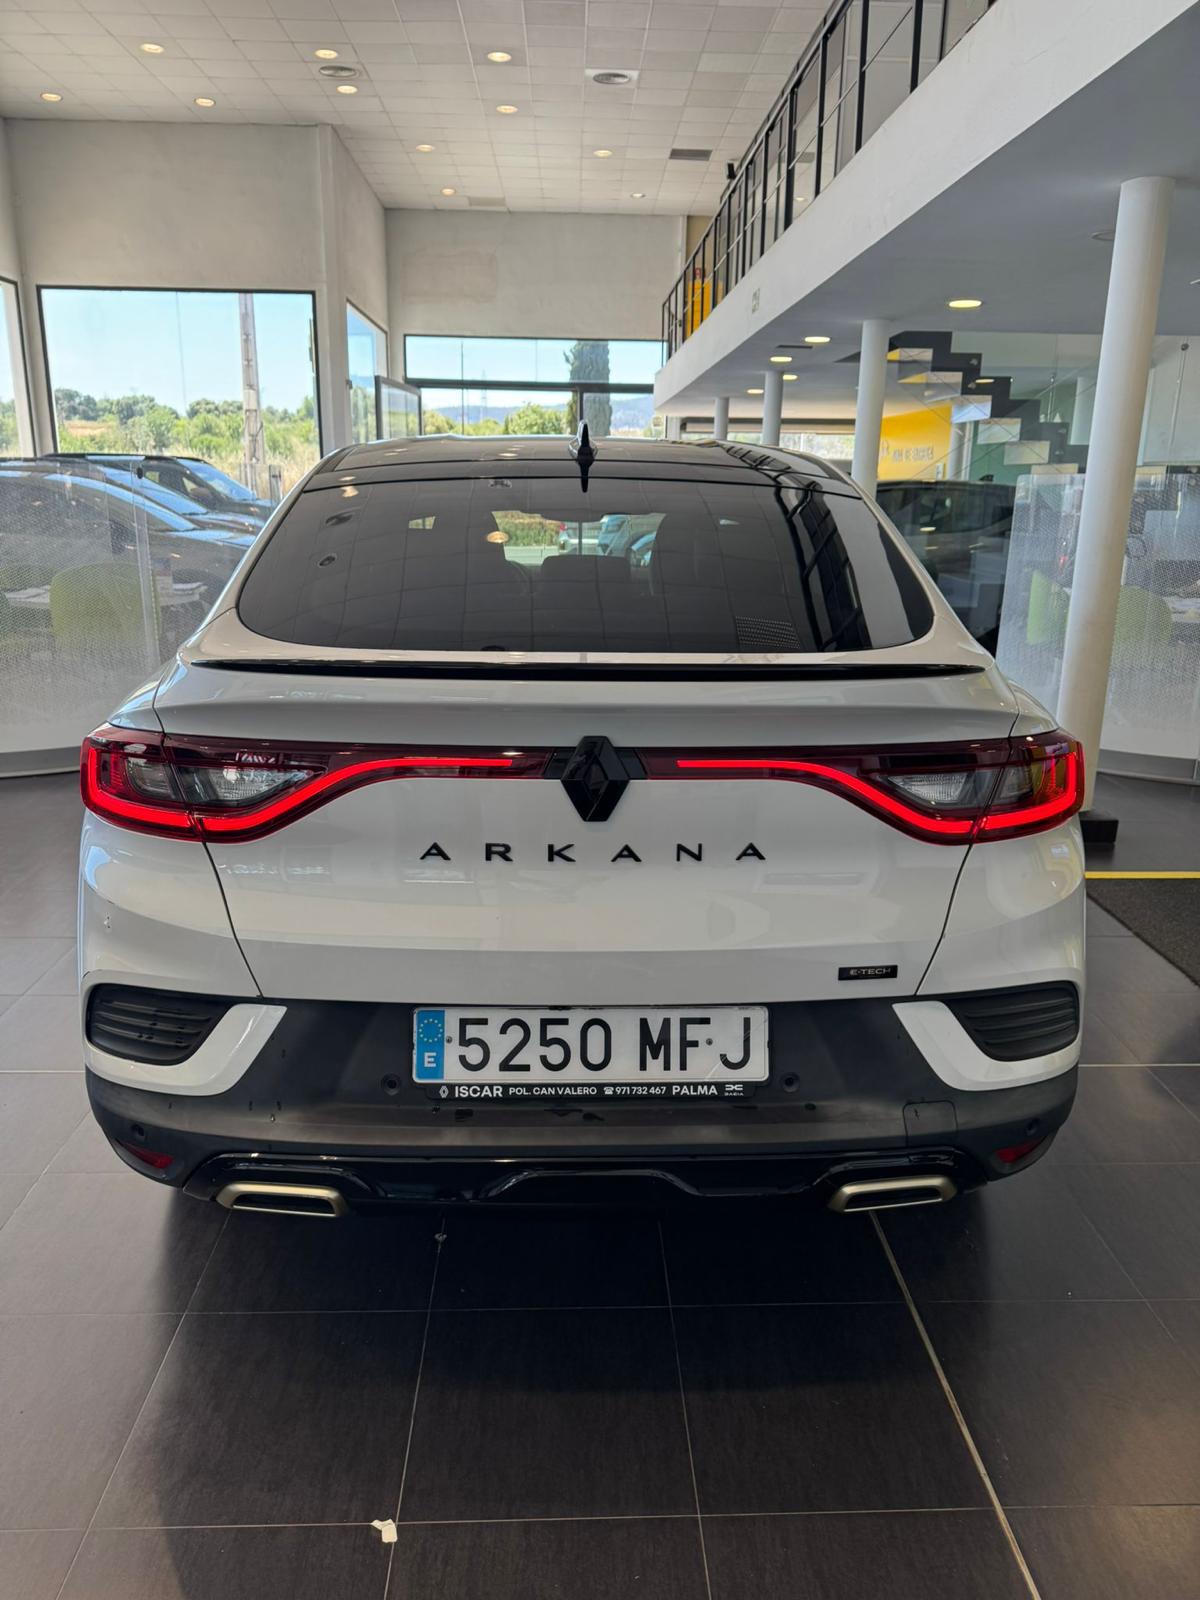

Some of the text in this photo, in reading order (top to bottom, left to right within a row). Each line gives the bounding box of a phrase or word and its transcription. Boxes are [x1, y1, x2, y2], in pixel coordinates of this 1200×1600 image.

[419, 842, 766, 862] ARKANA
[458, 1016, 751, 1072] 5250 MFJ
[424, 1052, 437, 1068] E
[454, 1085, 503, 1098] ISCAR
[509, 1086, 531, 1096] POL.
[533, 1086, 556, 1095] CAN
[557, 1086, 597, 1095] VALERO
[672, 1085, 718, 1096] PALMA
